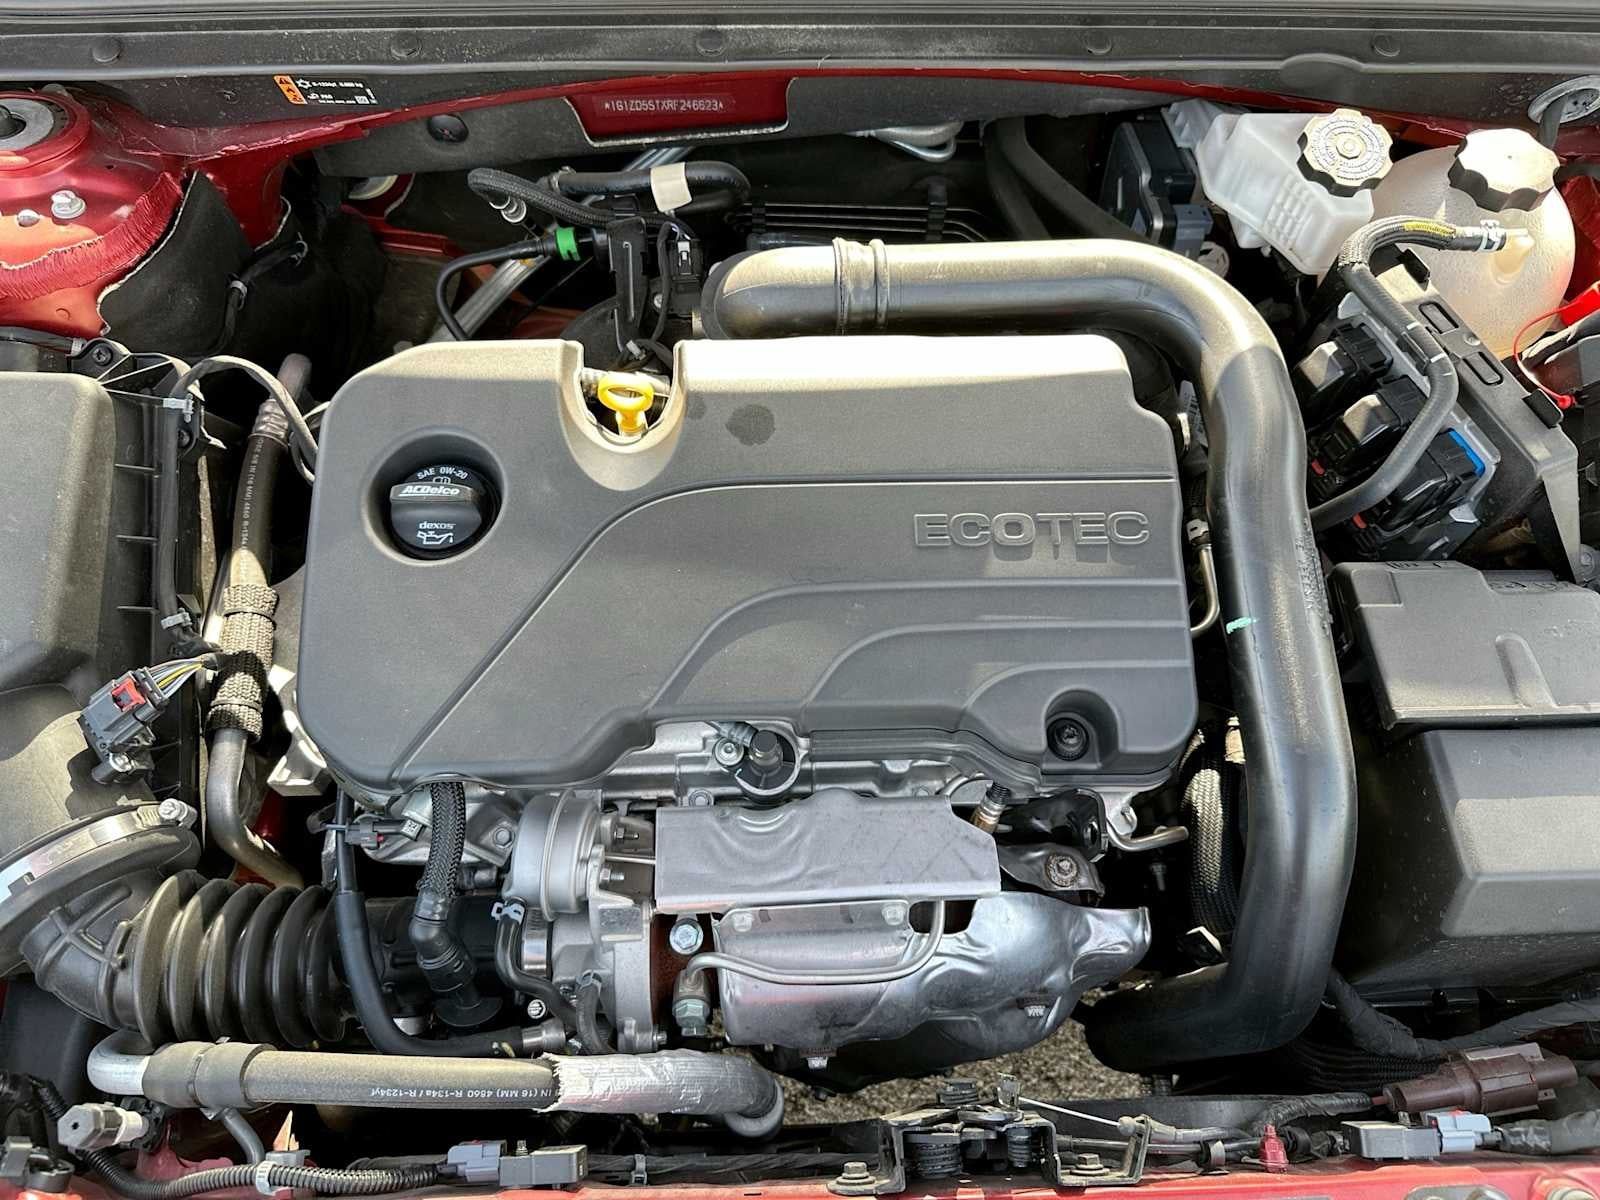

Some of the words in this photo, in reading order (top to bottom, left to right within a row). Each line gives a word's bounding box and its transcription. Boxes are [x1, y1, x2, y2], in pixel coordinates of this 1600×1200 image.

[417, 467, 435, 480] SAE
[440, 466, 469, 480] 0W-20
[401, 485, 460, 495] ACDelco
[419, 521, 456, 530] dexos
[914, 511, 1150, 546] ECOTEC
[426, 1089, 464, 1098] R-134a
[496, 1088, 519, 1098] MM)
[522, 1088, 539, 1098] (16
[540, 1088, 552, 1097] IN
